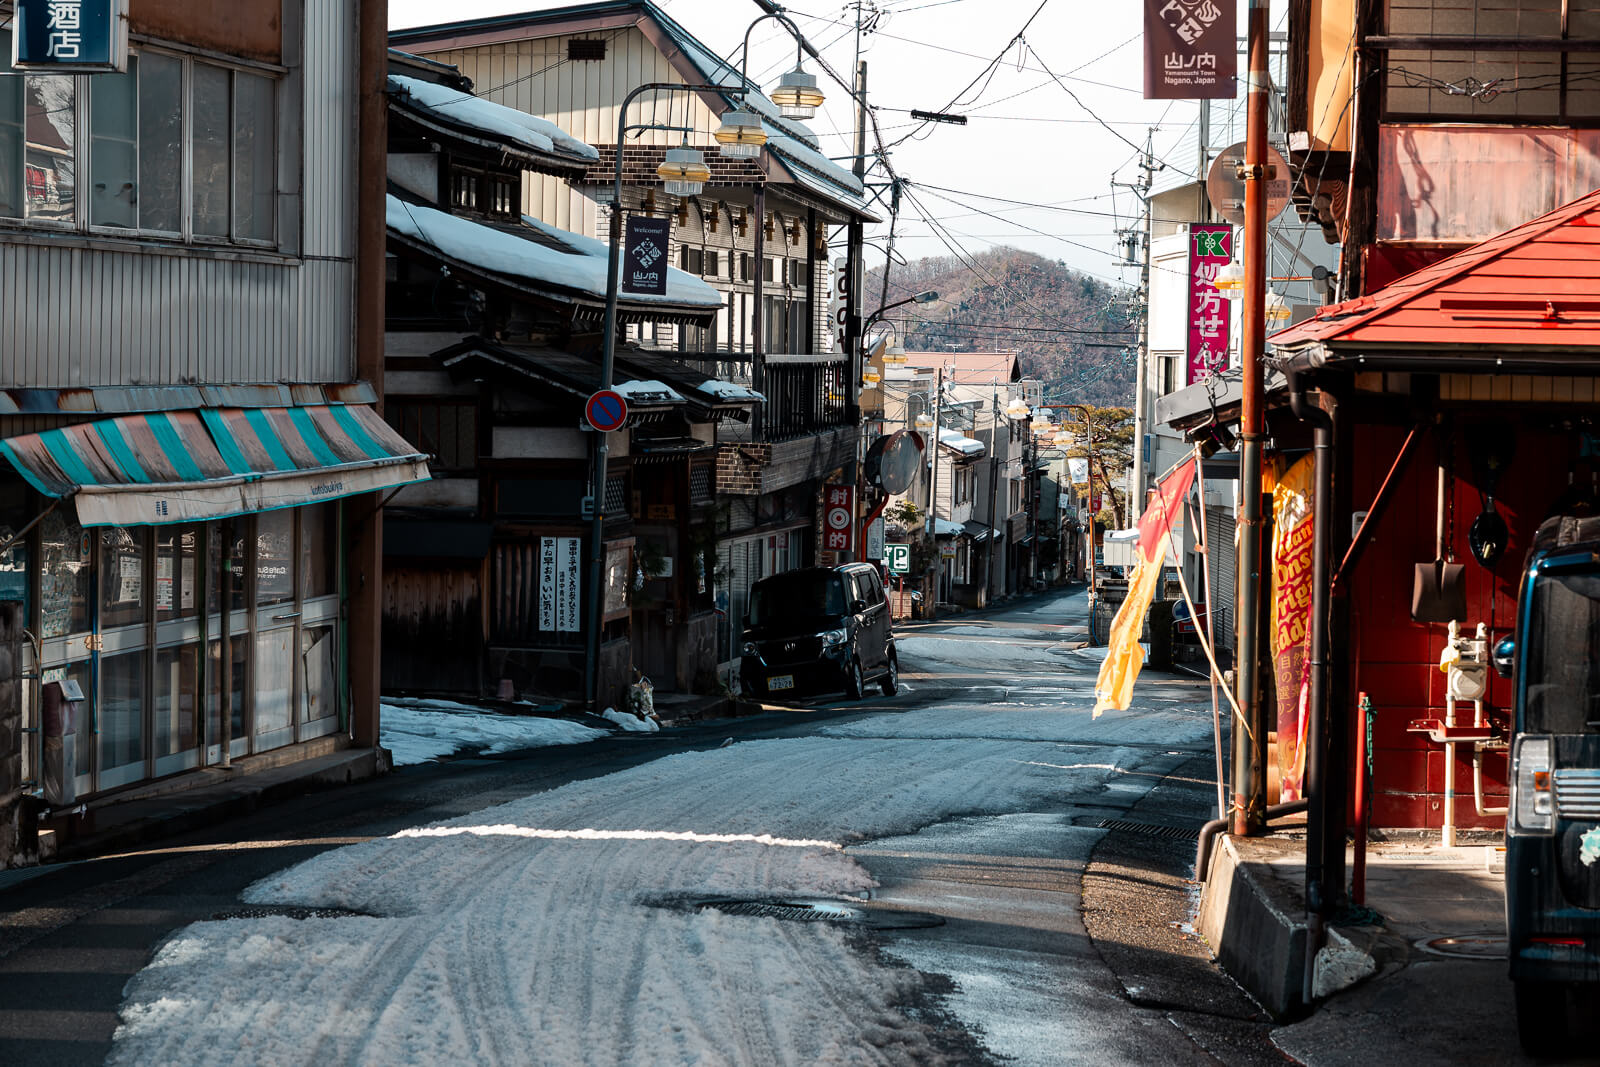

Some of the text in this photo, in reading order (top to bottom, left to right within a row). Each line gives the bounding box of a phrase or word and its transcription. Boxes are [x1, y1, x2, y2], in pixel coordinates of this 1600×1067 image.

[46, 0, 81, 57] 酒店
[1164, 52, 1216, 69] 山ノ内
[1164, 77, 1216, 85] Nagano, Japan
[633, 270, 658, 281] 山ノ内
[311, 481, 343, 495] kotobukiya
[1278, 551, 1312, 588] Ons
